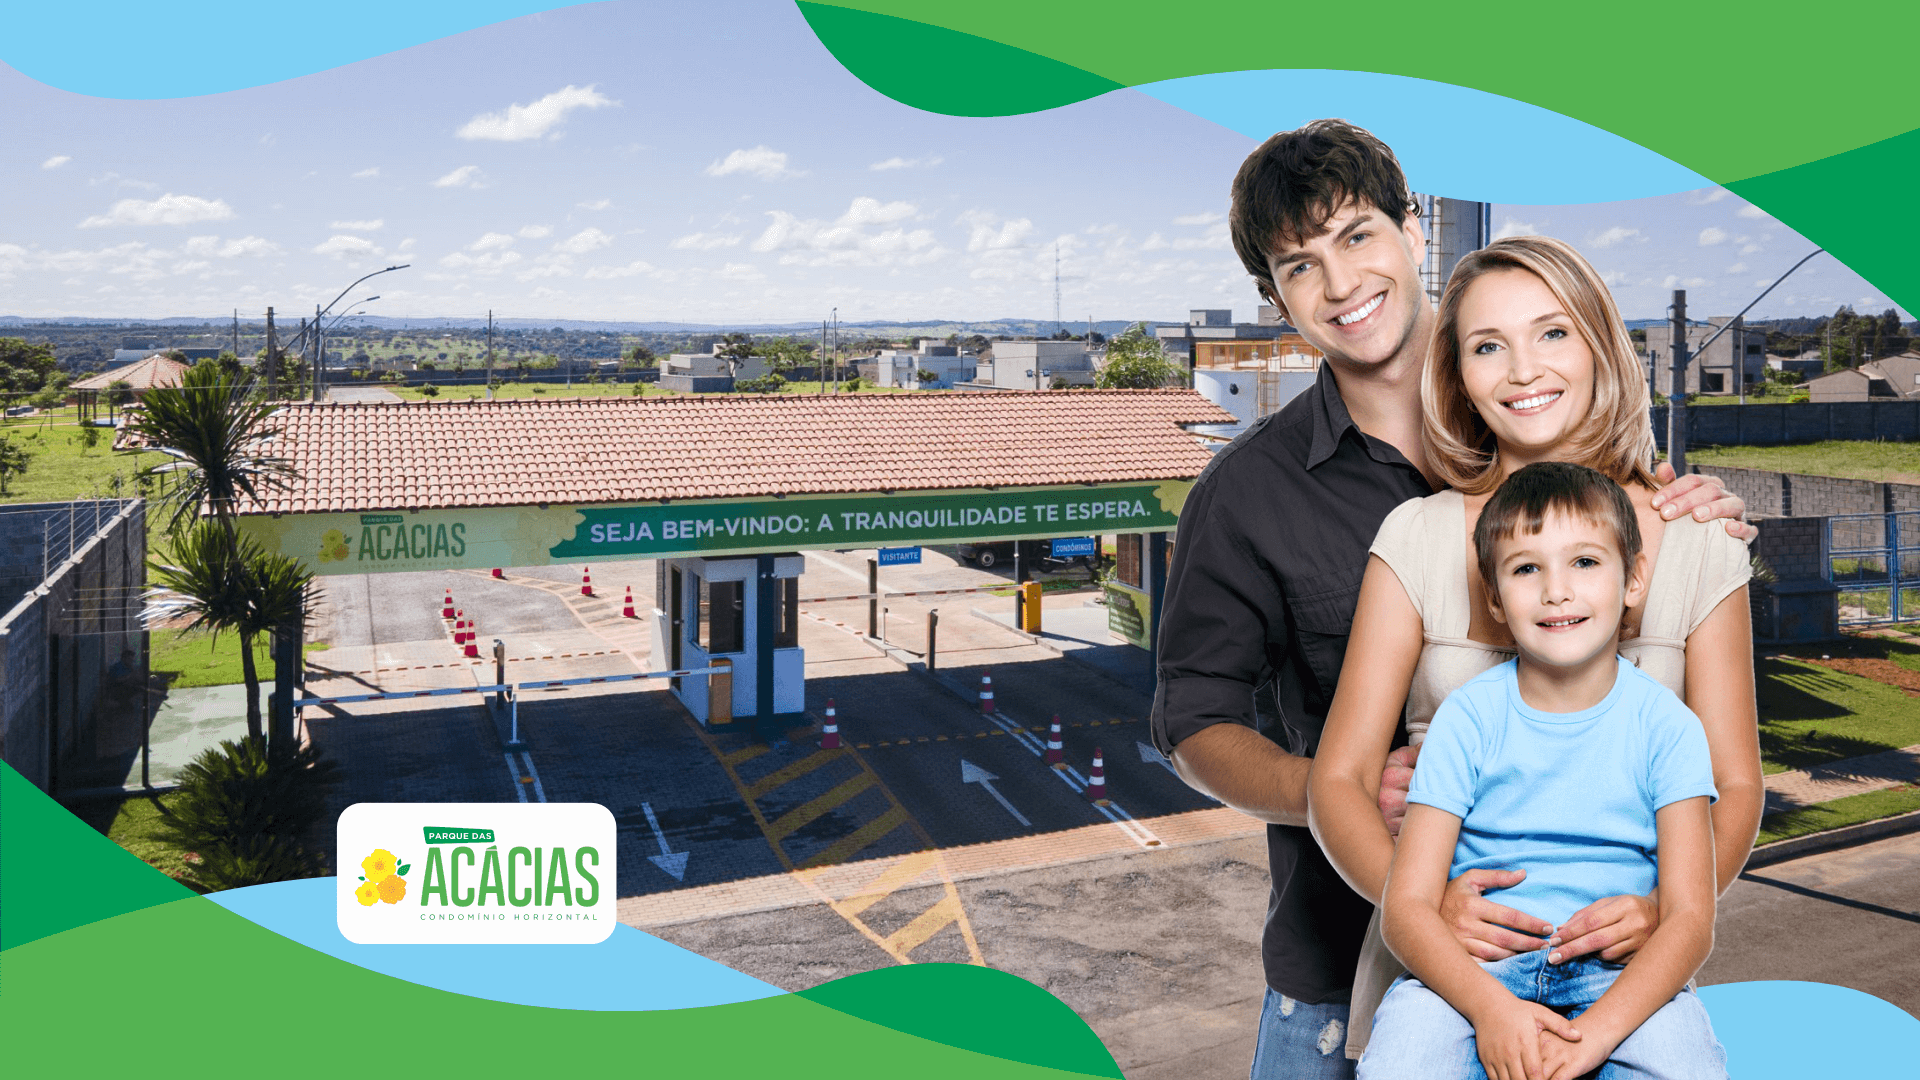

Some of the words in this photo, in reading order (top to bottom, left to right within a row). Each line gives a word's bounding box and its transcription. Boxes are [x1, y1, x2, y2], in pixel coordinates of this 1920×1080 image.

[590, 521, 655, 543] SEJA
[662, 515, 810, 539] BEM-VINDO:
[817, 513, 834, 532] A
[841, 504, 1027, 531] TRANQUILIDADE
[1033, 504, 1059, 522] TE
[1066, 499, 1151, 521] ESPERA.
[881, 551, 919, 562] VISITANTE
